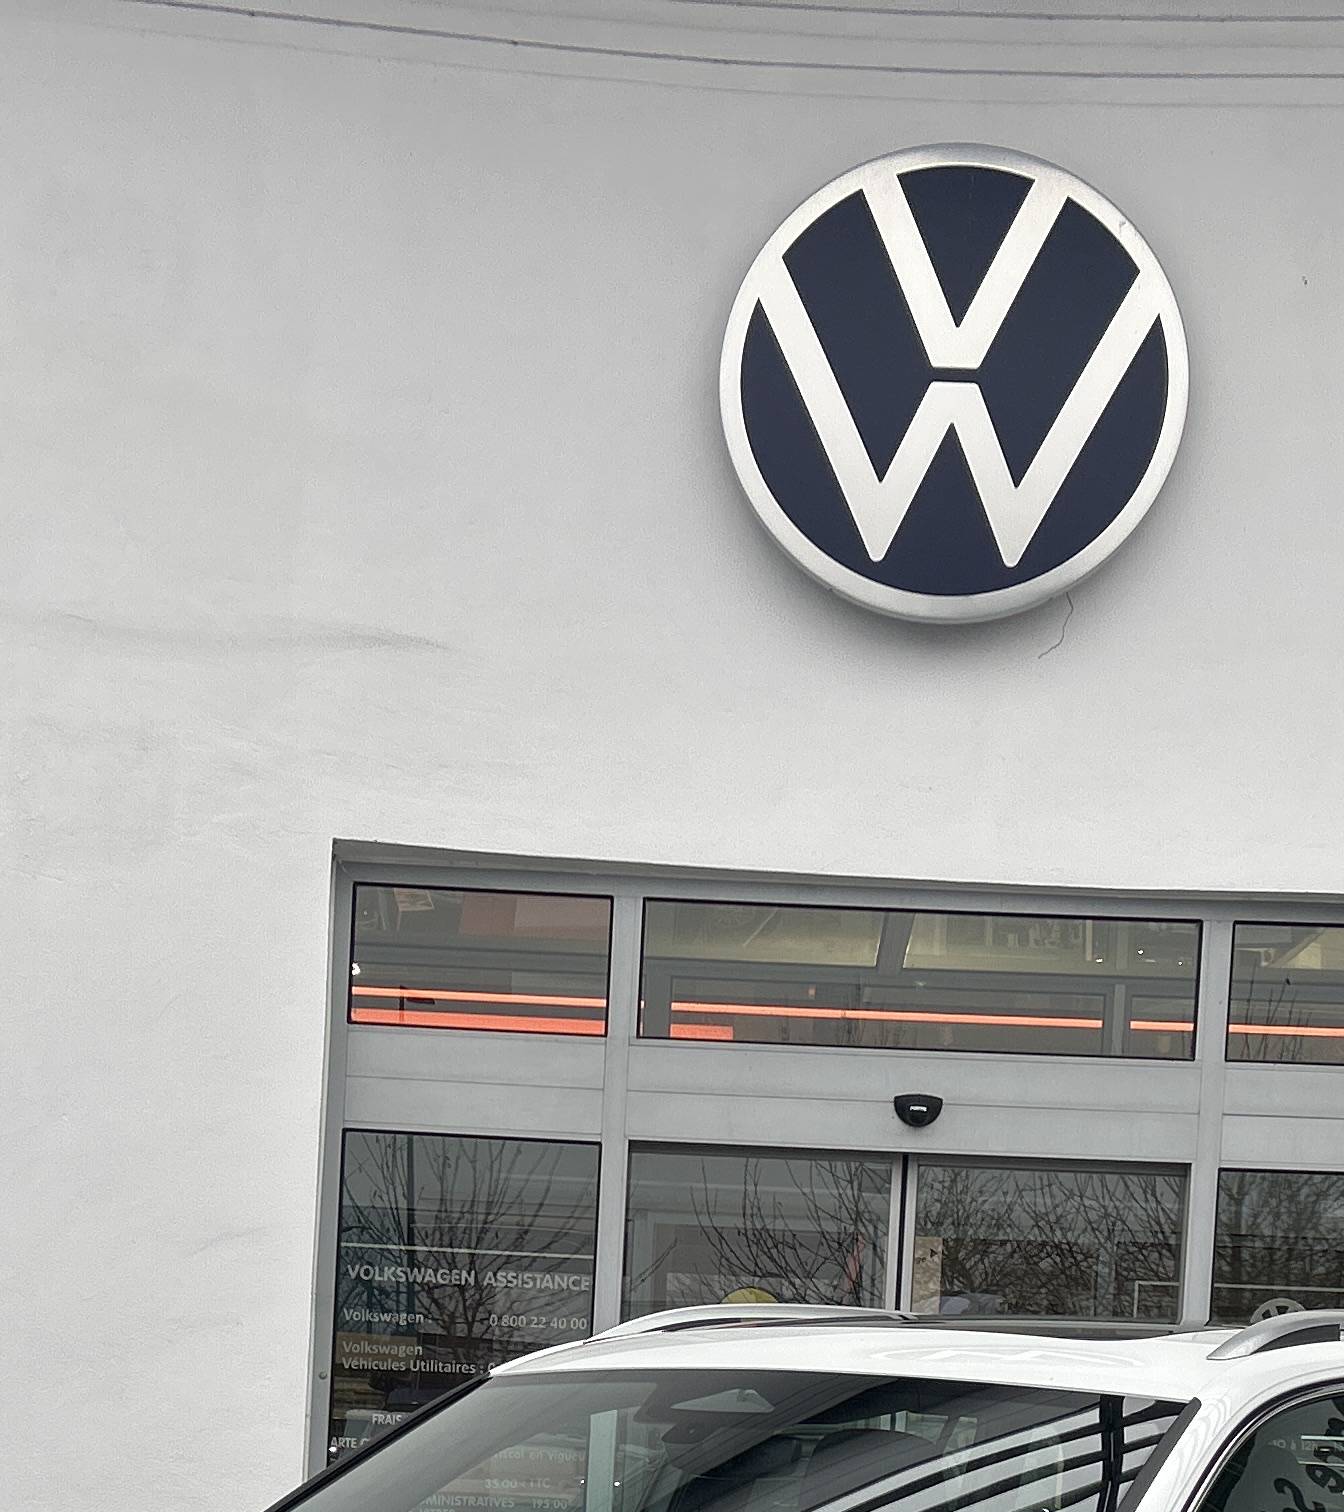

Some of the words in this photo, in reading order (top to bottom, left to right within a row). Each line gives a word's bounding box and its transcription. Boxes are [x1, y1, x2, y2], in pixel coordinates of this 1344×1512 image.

[346, 1264, 476, 1286] VOLKSWAGEN
[483, 1271, 591, 1292] ASSISTANCE
[342, 1308, 425, 1326] Volkswagen
[489, 1313, 497, 1327] 0
[500, 1315, 527, 1327] 800
[529, 1316, 545, 1328] 22
[548, 1317, 567, 1329] 40
[569, 1317, 588, 1330] 00
[342, 1341, 423, 1357] Volkswagen
[409, 1359, 477, 1374] Utilitaires
